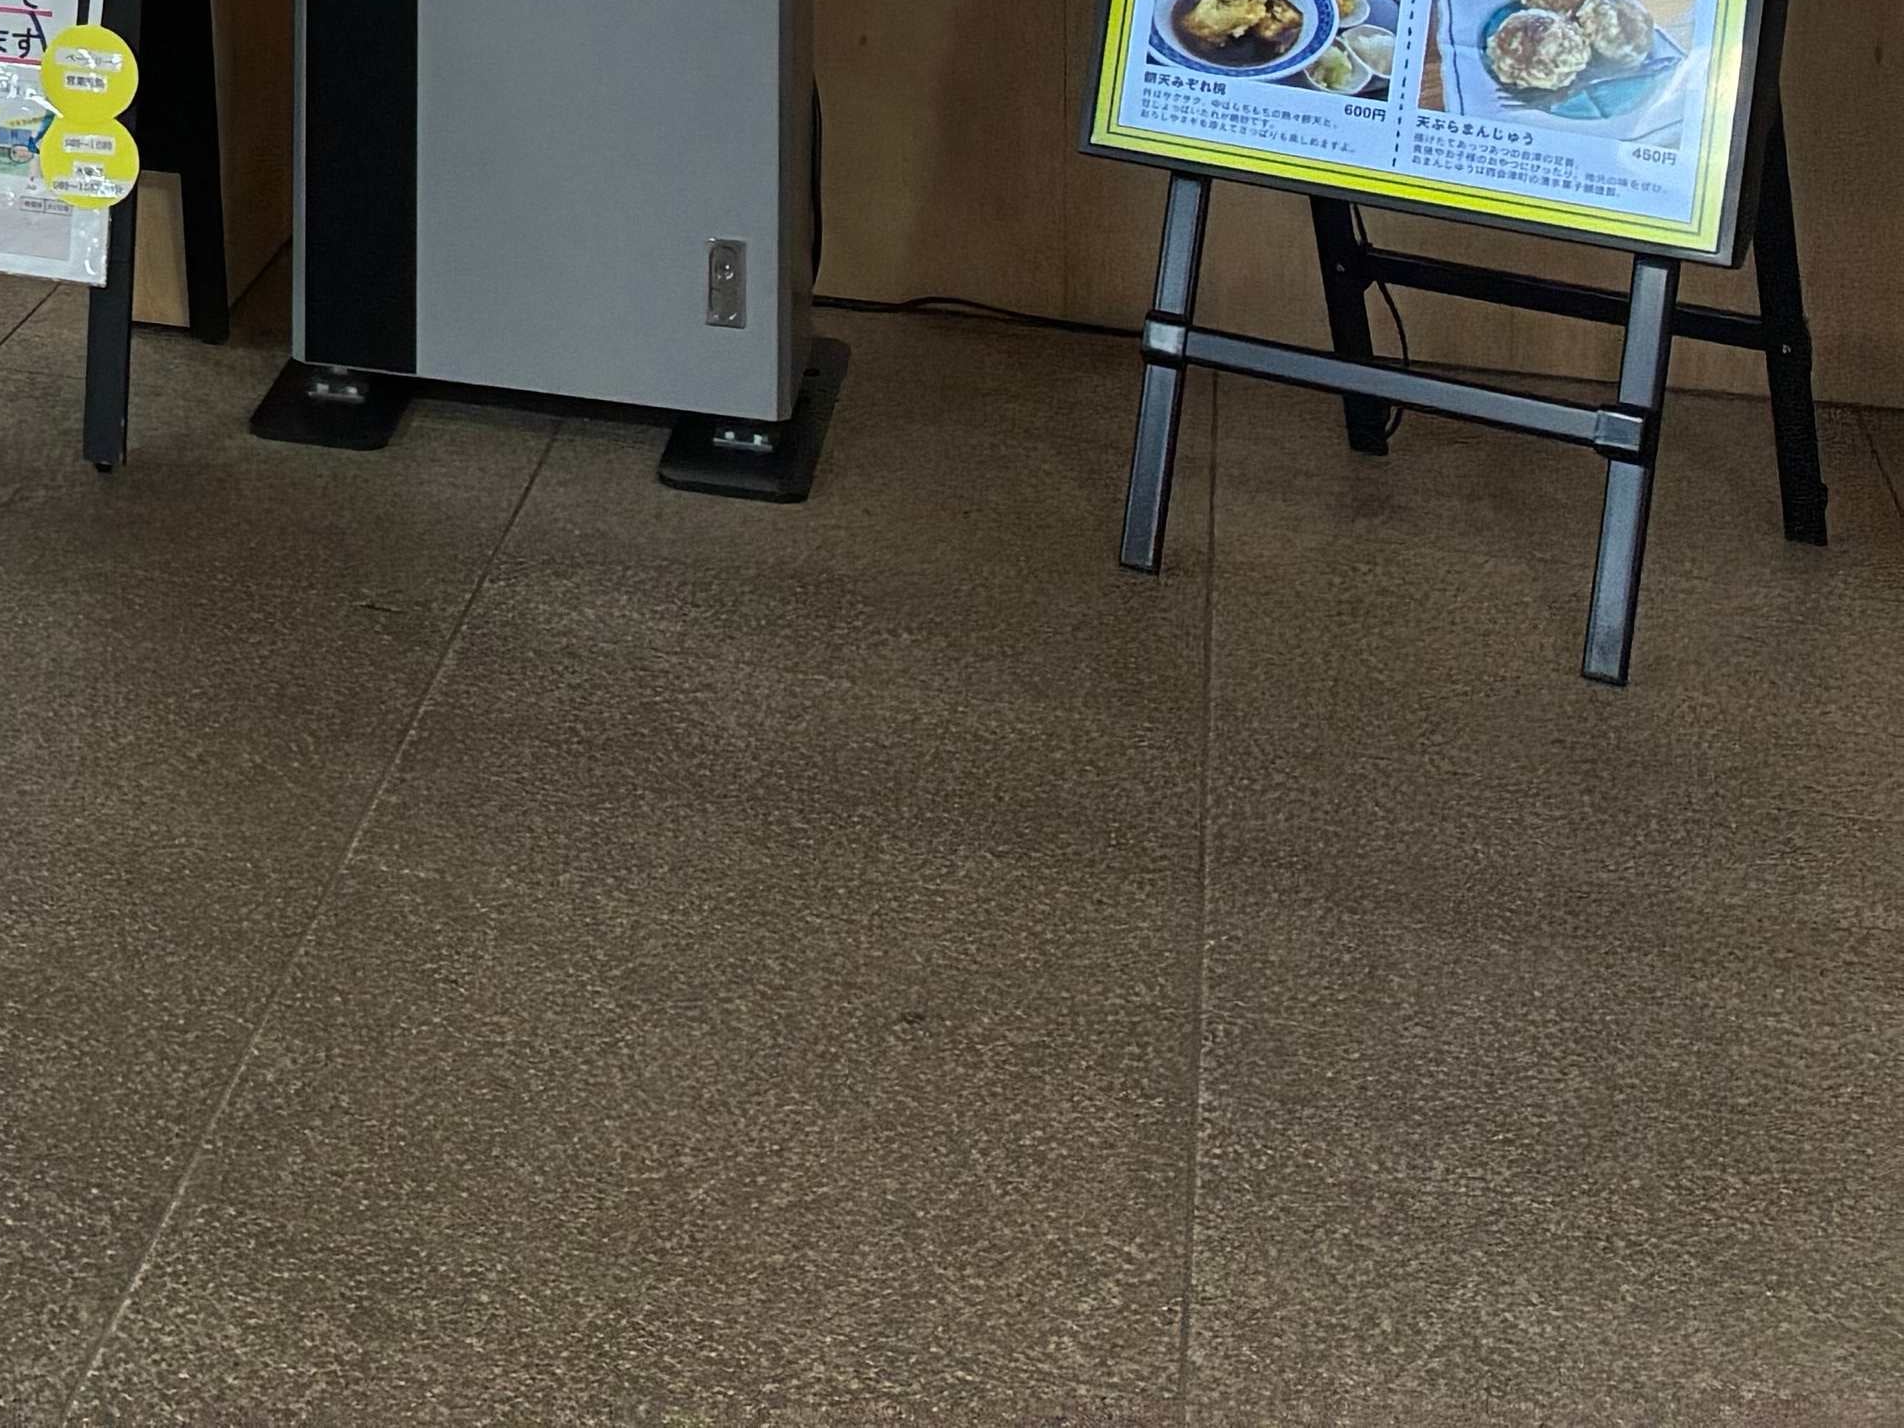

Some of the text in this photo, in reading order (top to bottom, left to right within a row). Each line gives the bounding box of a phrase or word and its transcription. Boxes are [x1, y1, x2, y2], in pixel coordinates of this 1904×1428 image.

[1344, 104, 1386, 123] 600円
[1417, 116, 1534, 145] 天ぷらまんじゅう
